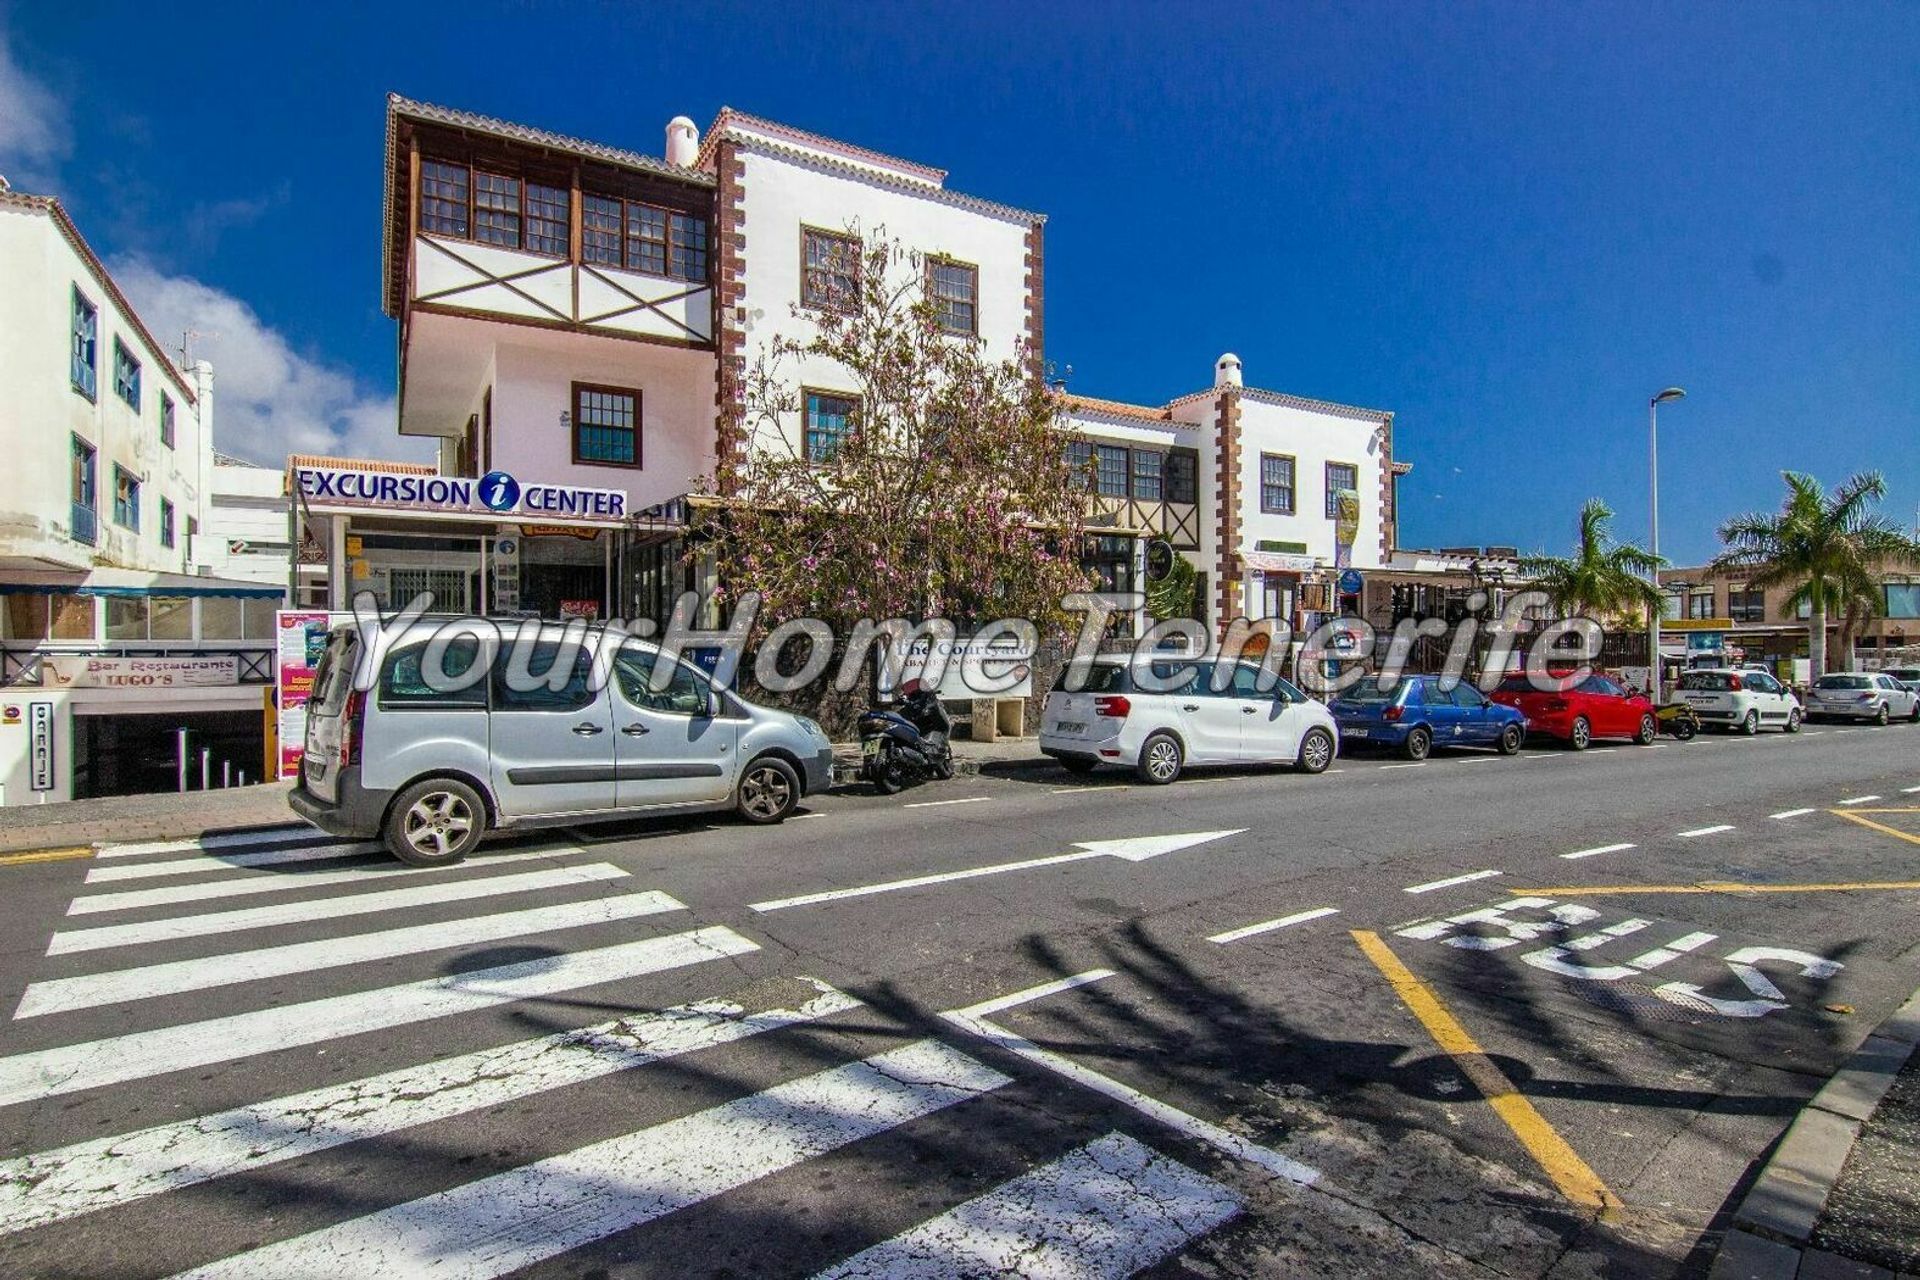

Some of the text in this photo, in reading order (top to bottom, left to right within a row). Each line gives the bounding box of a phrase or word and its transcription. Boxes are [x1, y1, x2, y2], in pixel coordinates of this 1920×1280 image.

[299, 470, 471, 504] EXCURSION
[525, 487, 625, 516] CENTER
[87, 659, 234, 673] Bar Restaurante
[1393, 896, 1845, 1017] BUS
